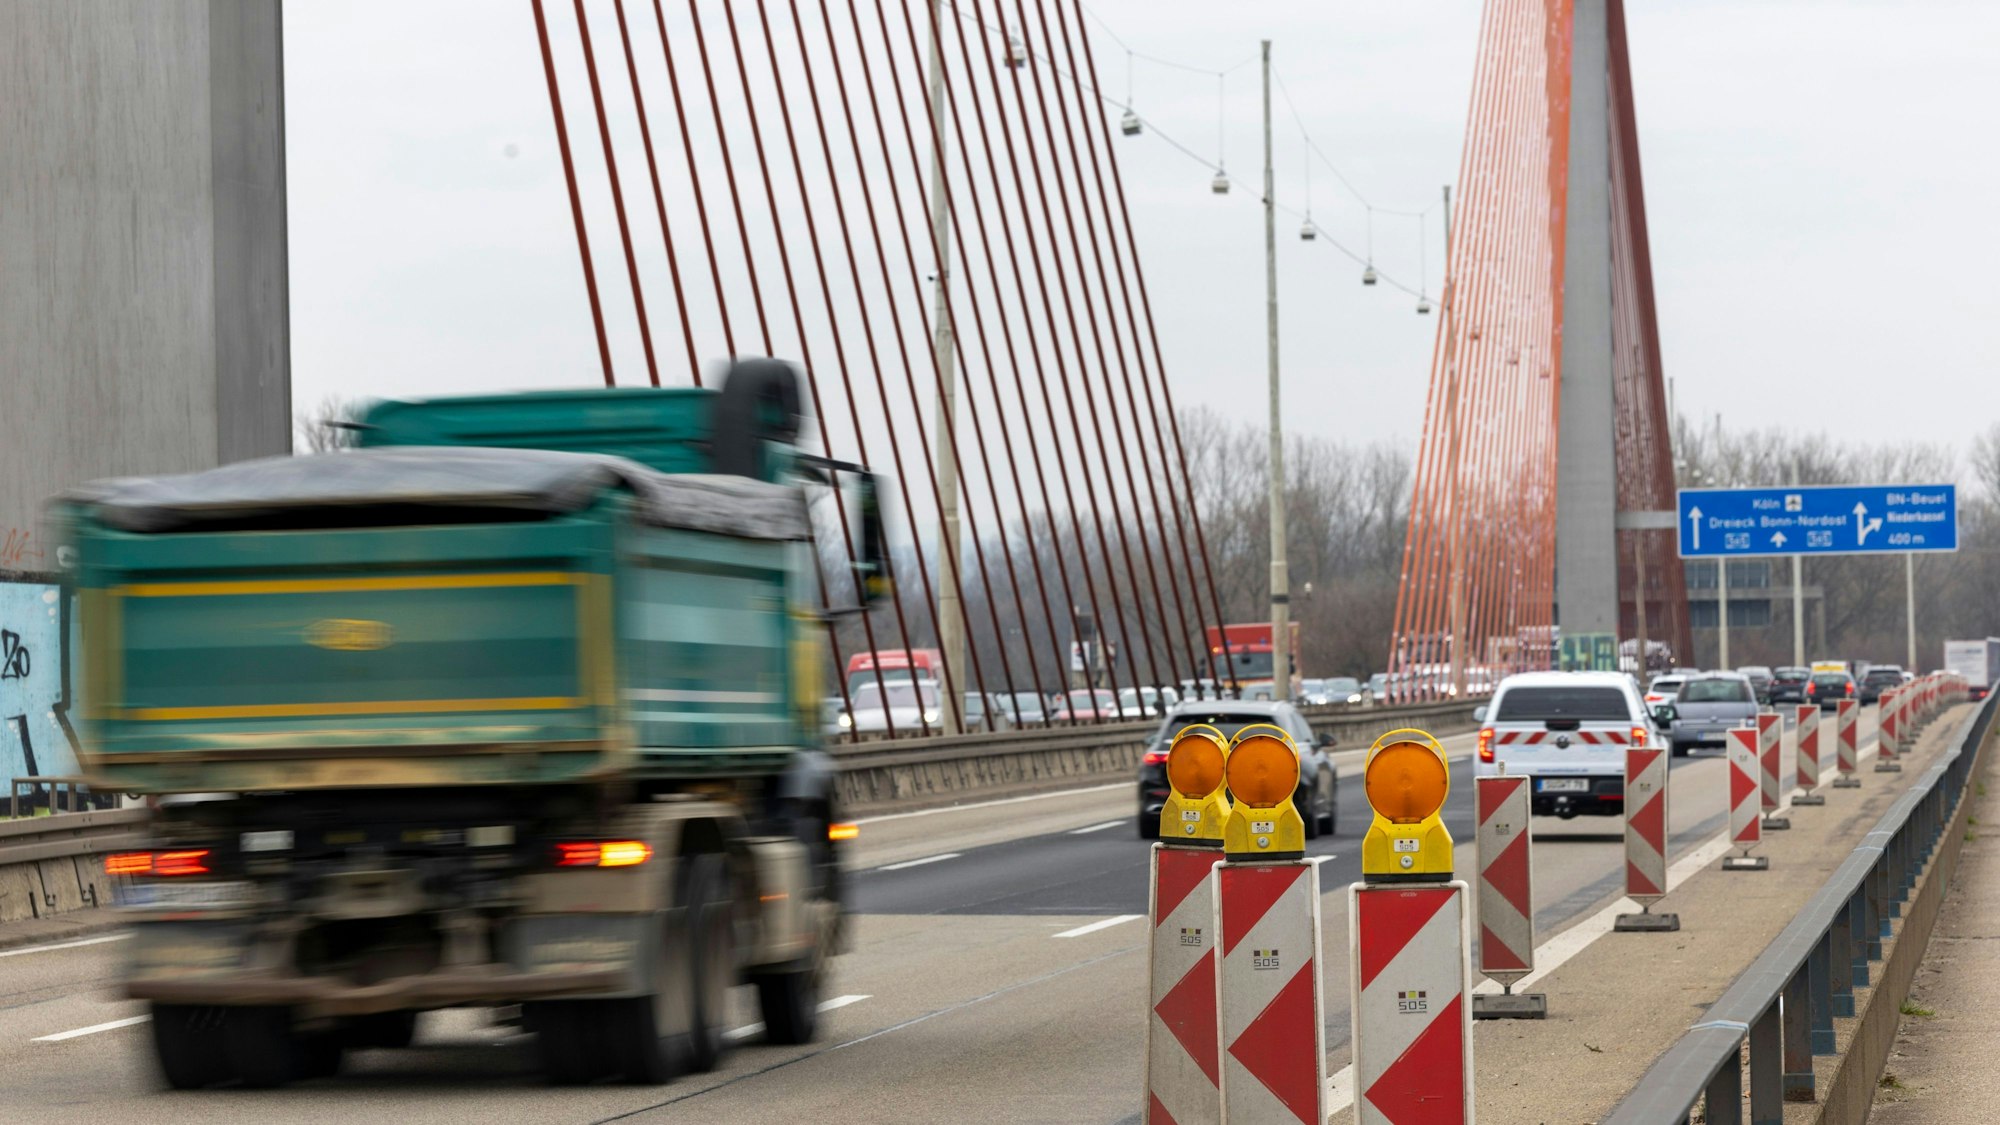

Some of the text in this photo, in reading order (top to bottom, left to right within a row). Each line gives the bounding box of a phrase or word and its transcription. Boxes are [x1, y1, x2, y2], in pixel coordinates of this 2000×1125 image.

[1753, 498, 1780, 510] Köln
[1886, 492, 1946, 505] BN-Beuel
[1709, 515, 1847, 529] Dreieck Bonn-Nordost
[1887, 511, 1945, 523] Niederkassel
[1888, 533, 1925, 545] 400 m
[1180, 935, 1202, 944] SOS
[1254, 958, 1279, 967] SOS
[1398, 1000, 1427, 1011] SOS
